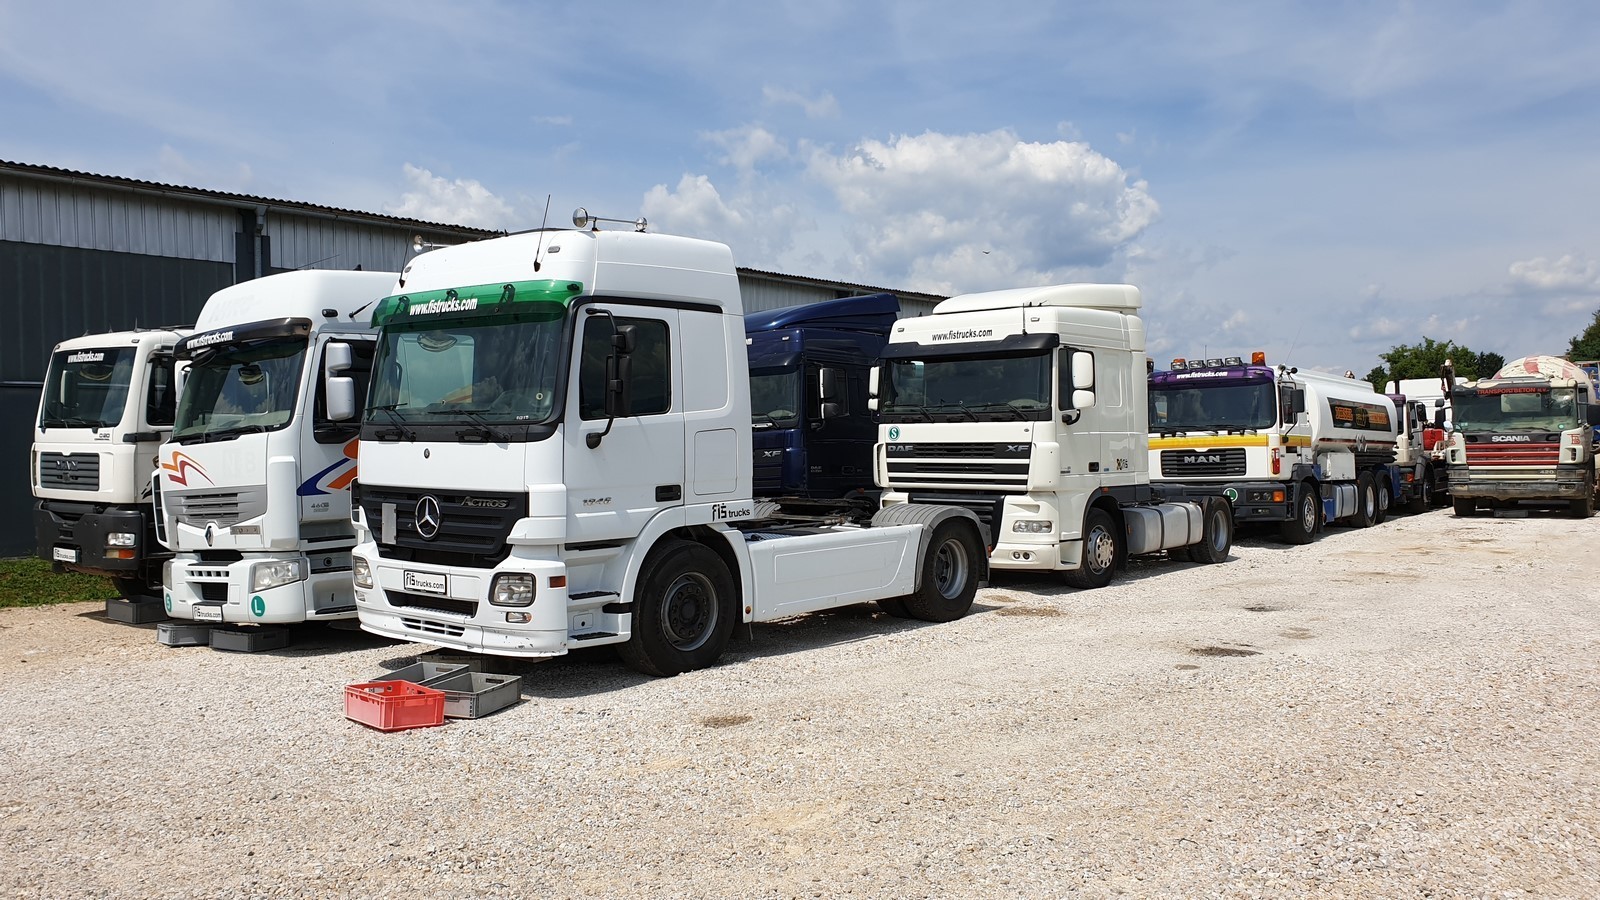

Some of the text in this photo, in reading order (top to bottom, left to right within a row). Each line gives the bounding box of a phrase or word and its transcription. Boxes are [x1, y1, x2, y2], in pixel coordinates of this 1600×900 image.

[408, 297, 478, 316] www.fistrucks.com
[931, 328, 993, 341] www.fistrucks.com
[1477, 387, 1536, 395] TRANSPORTBETON
[1184, 455, 1220, 464] MAN
[728, 507, 751, 518] trucks
[416, 579, 445, 590] trucks.com
[253, 598, 262, 614] L
